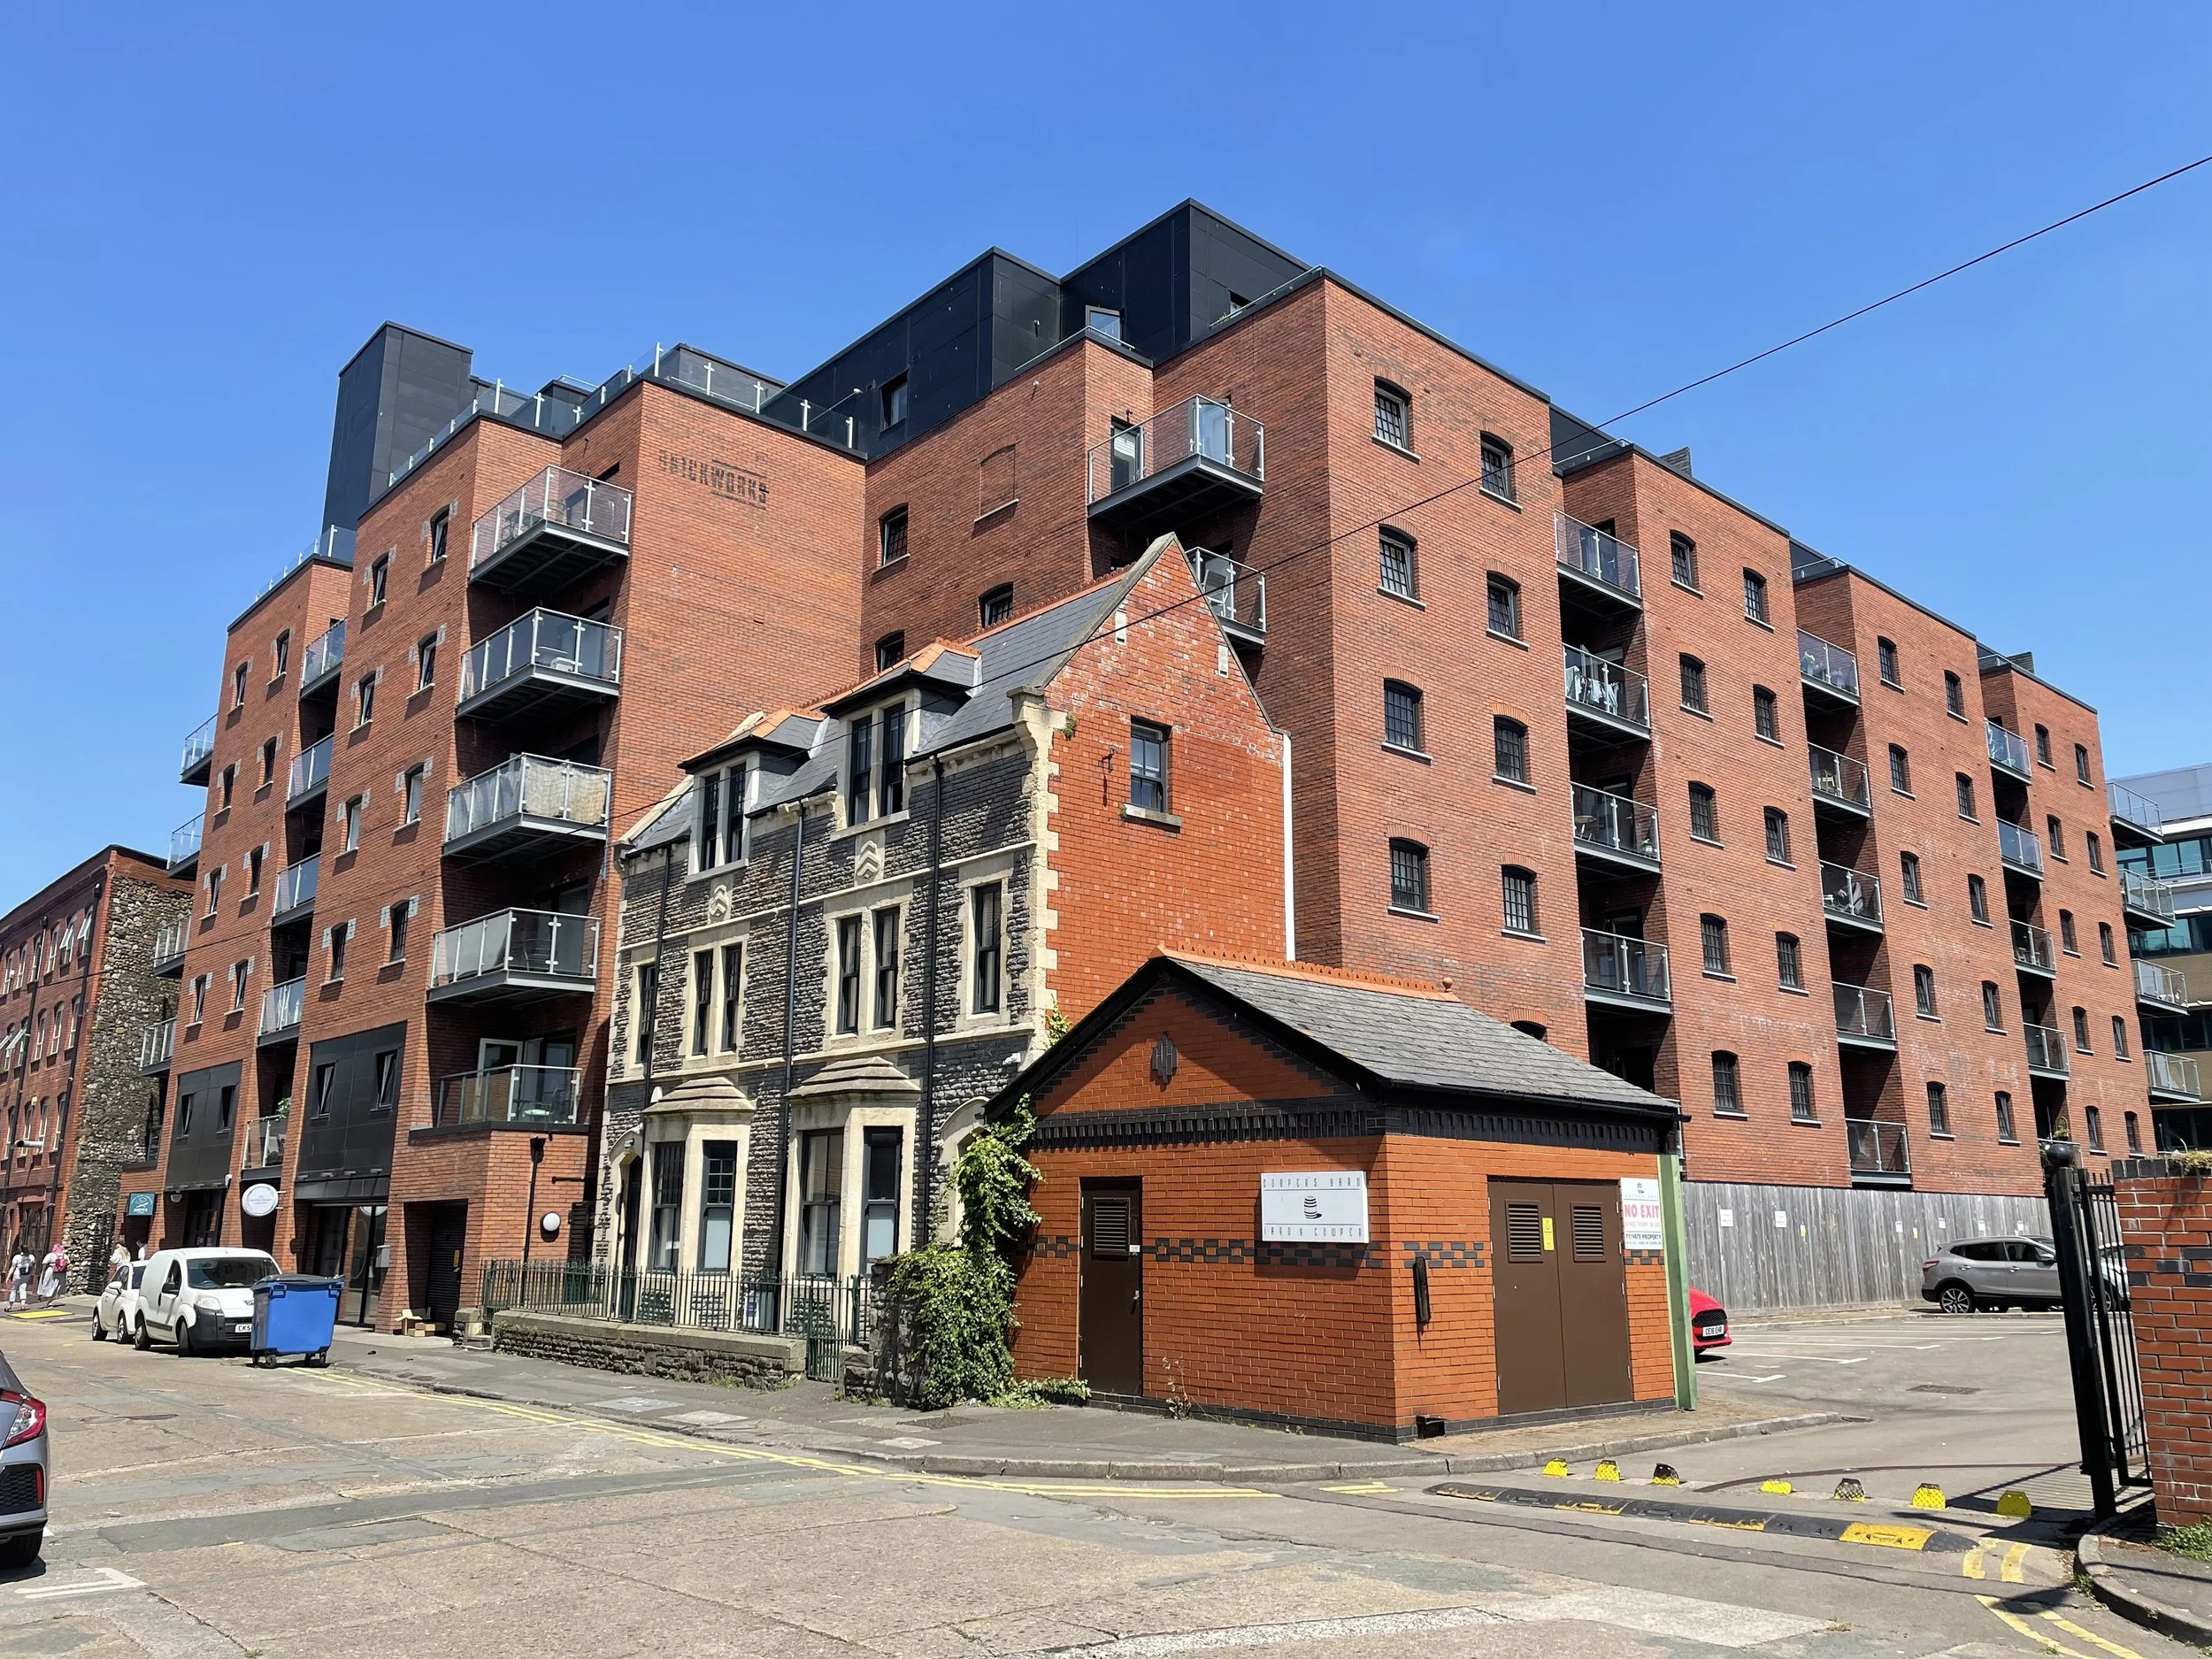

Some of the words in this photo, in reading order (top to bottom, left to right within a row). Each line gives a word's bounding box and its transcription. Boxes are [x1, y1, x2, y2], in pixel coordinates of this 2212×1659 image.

[1263, 1178, 1317, 1187] COOPERS
[1330, 1178, 1360, 1187] YARD
[1624, 1204, 1638, 1217] NO
[1640, 1204, 1660, 1218] EXIT
